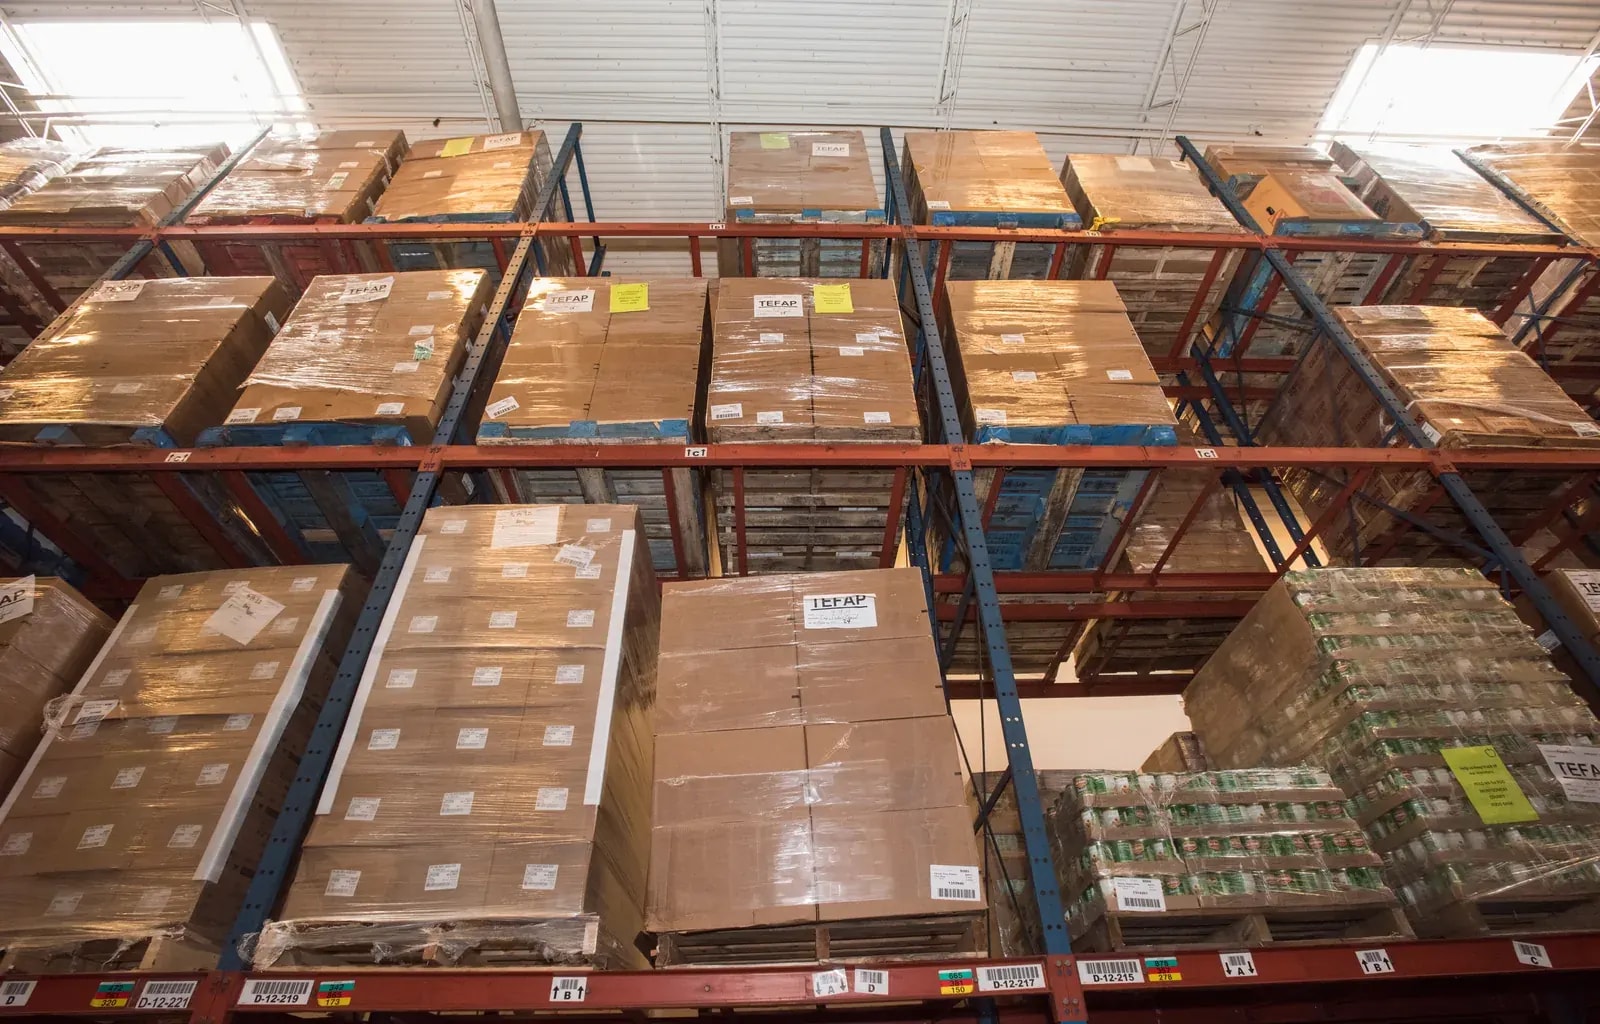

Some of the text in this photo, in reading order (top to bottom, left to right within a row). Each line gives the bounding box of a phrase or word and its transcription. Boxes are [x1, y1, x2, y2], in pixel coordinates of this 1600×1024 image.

[349, 284, 388, 296] TEFAP
[551, 294, 590, 304] TEFAP
[1530, 956, 1539, 965] C
[1237, 967, 1245, 976] A
[1373, 963, 1382, 972] B
[1093, 973, 1135, 982] D-12-215
[868, 984, 875, 992] D
[993, 979, 1035, 989] D-12-217
[827, 986, 835, 994] A
[254, 994, 299, 1003] D-12-219
[563, 991, 571, 999] B
[5, 996, 15, 1004] D
[101, 999, 117, 1007] 320
[138, 997, 189, 1008] D-12-221
